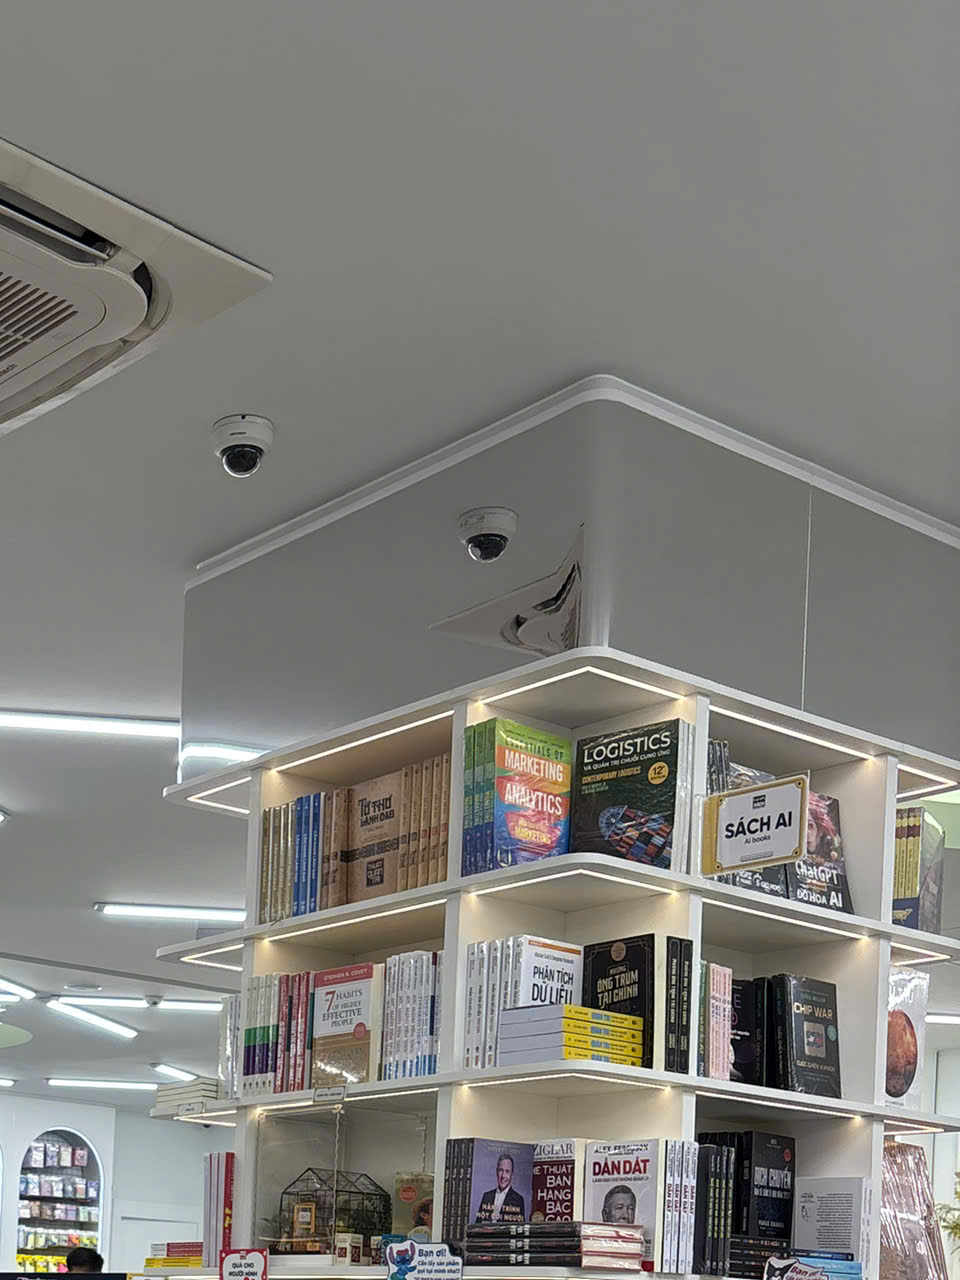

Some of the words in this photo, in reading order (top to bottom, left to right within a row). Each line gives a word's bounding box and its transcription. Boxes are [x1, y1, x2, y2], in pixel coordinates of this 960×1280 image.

[583, 731, 671, 763] LOGISTICS
[504, 749, 564, 782] MARKETING
[618, 766, 641, 779] LOGISTICS
[504, 783, 563, 815] ANALYTICS
[724, 813, 771, 839] SÁCH
[775, 811, 793, 828] AI
[753, 834, 771, 844] books
[795, 860, 838, 885] ChatGPT
[829, 891, 843, 908] AI
[533, 965, 553, 981] PHÂN
[324, 990, 336, 1013] 7
[335, 989, 363, 1001] HABITS
[341, 1000, 362, 1009] HIGHLY
[322, 1008, 362, 1022] EFFECTIVE
[793, 1001, 813, 1016] CHIP
[814, 1006, 833, 1020] WAR
[331, 1018, 353, 1028] PEOPLE
[542, 1164, 572, 1176] THUẬT
[624, 1156, 650, 1175] DẮT
[418, 1248, 434, 1259] Bạn
